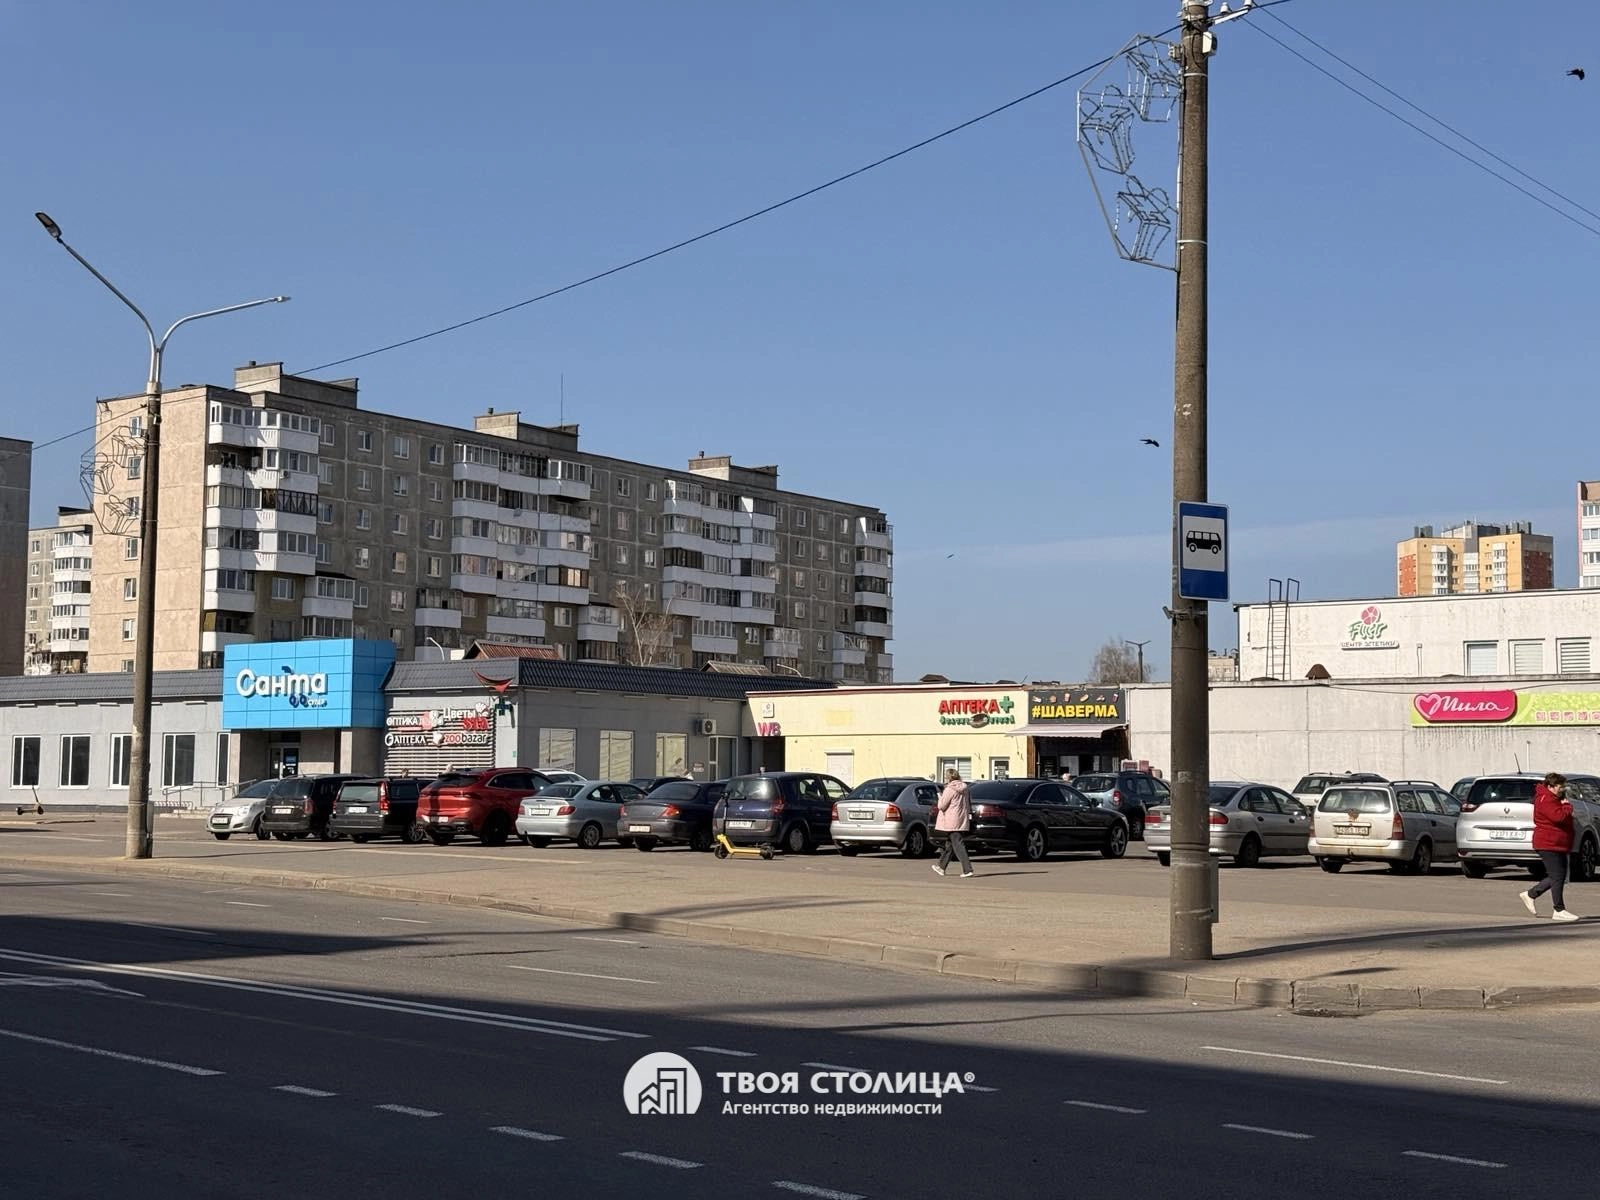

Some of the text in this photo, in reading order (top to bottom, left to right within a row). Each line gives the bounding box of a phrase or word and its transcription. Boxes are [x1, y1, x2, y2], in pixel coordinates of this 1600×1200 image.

[236, 668, 327, 698] Санта
[938, 699, 1000, 714] АПТЕКА
[1031, 704, 1118, 719] #ШАВЕРМА
[1425, 693, 1510, 715] Мила
[443, 707, 476, 720] Цветы
[386, 716, 418, 727] ОПТИКА
[757, 721, 782, 736] WB
[393, 735, 427, 744] АПТЕКА
[444, 733, 487, 743] zoobazar
